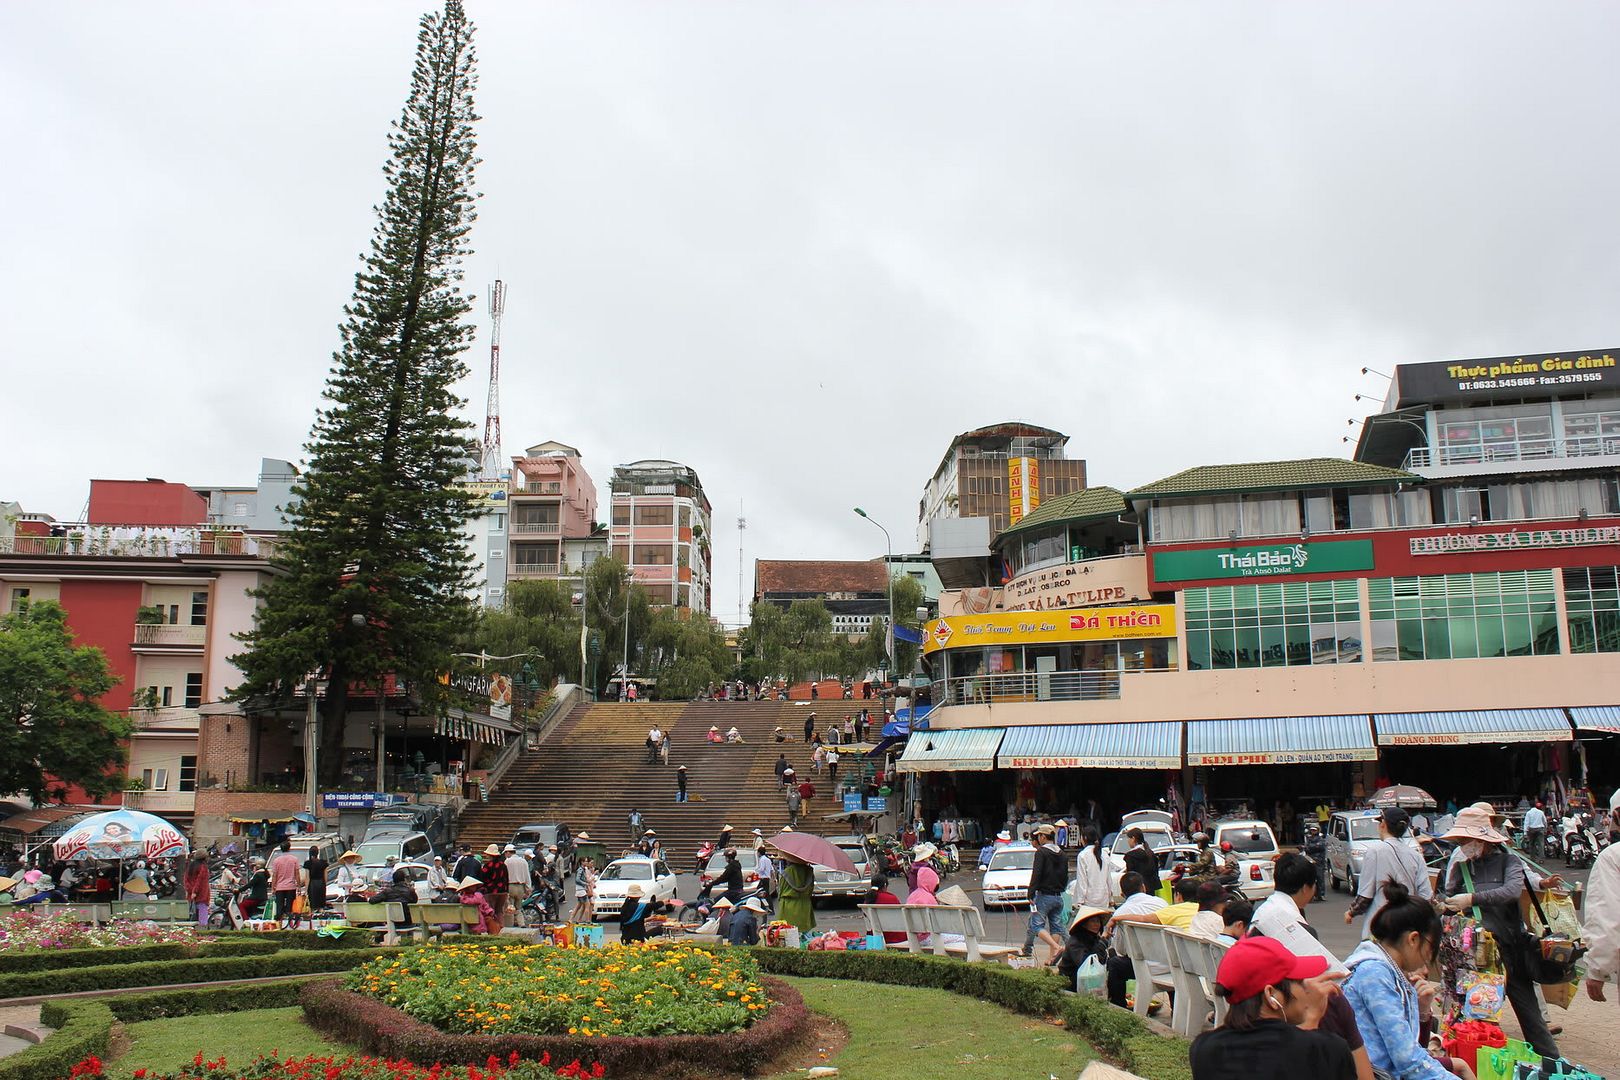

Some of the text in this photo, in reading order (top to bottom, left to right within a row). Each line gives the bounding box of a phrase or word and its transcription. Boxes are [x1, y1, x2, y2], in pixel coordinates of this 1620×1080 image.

[1447, 354, 1616, 380] Thực phẩm Gia đình
[1011, 466, 1021, 498] ANH
[1217, 550, 1291, 569] Thái Bảo
[1017, 586, 1037, 597] DLAT
[1066, 586, 1126, 606] TULIPE
[1070, 611, 1100, 629] BÁ
[1394, 734, 1425, 744] HOÀNG
[1427, 735, 1459, 743] NHUNG
[1012, 757, 1038, 766] KIM
[1041, 757, 1079, 766] OANH
[1202, 756, 1233, 764] KIM
[1336, 752, 1353, 760] TRANG
